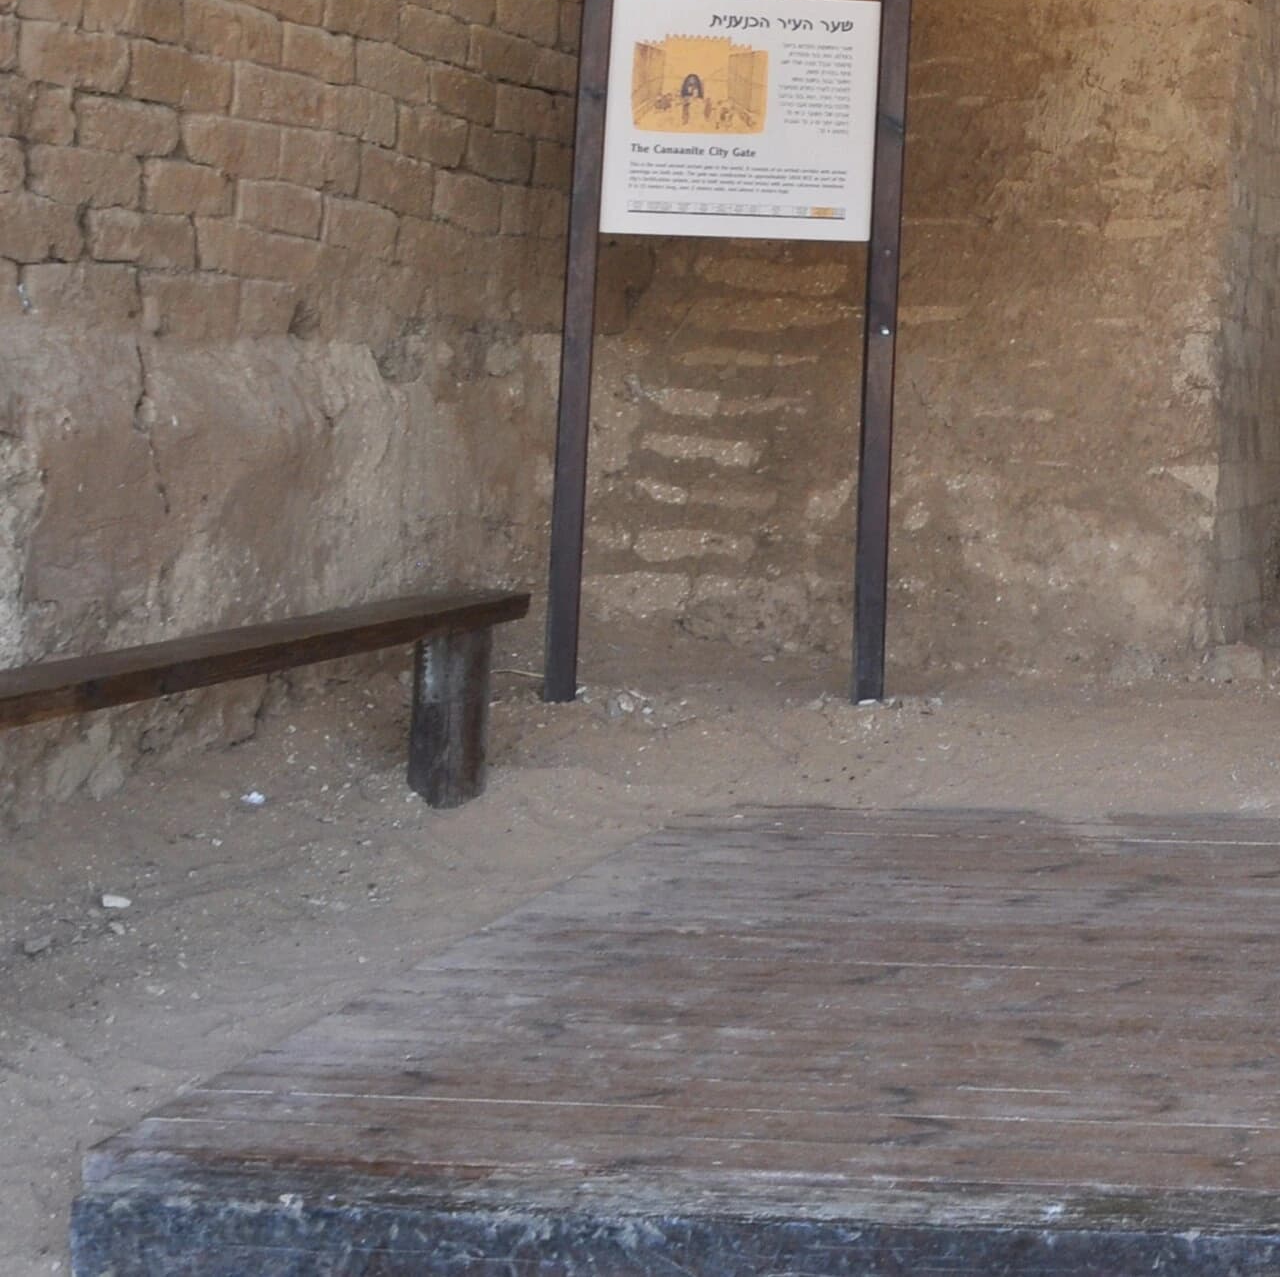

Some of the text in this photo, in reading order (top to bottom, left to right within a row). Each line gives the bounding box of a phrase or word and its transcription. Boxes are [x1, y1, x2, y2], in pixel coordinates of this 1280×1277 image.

[709, 14, 854, 33] שער העיר הכנענית
[631, 142, 757, 159] The Canaanite City Gate
